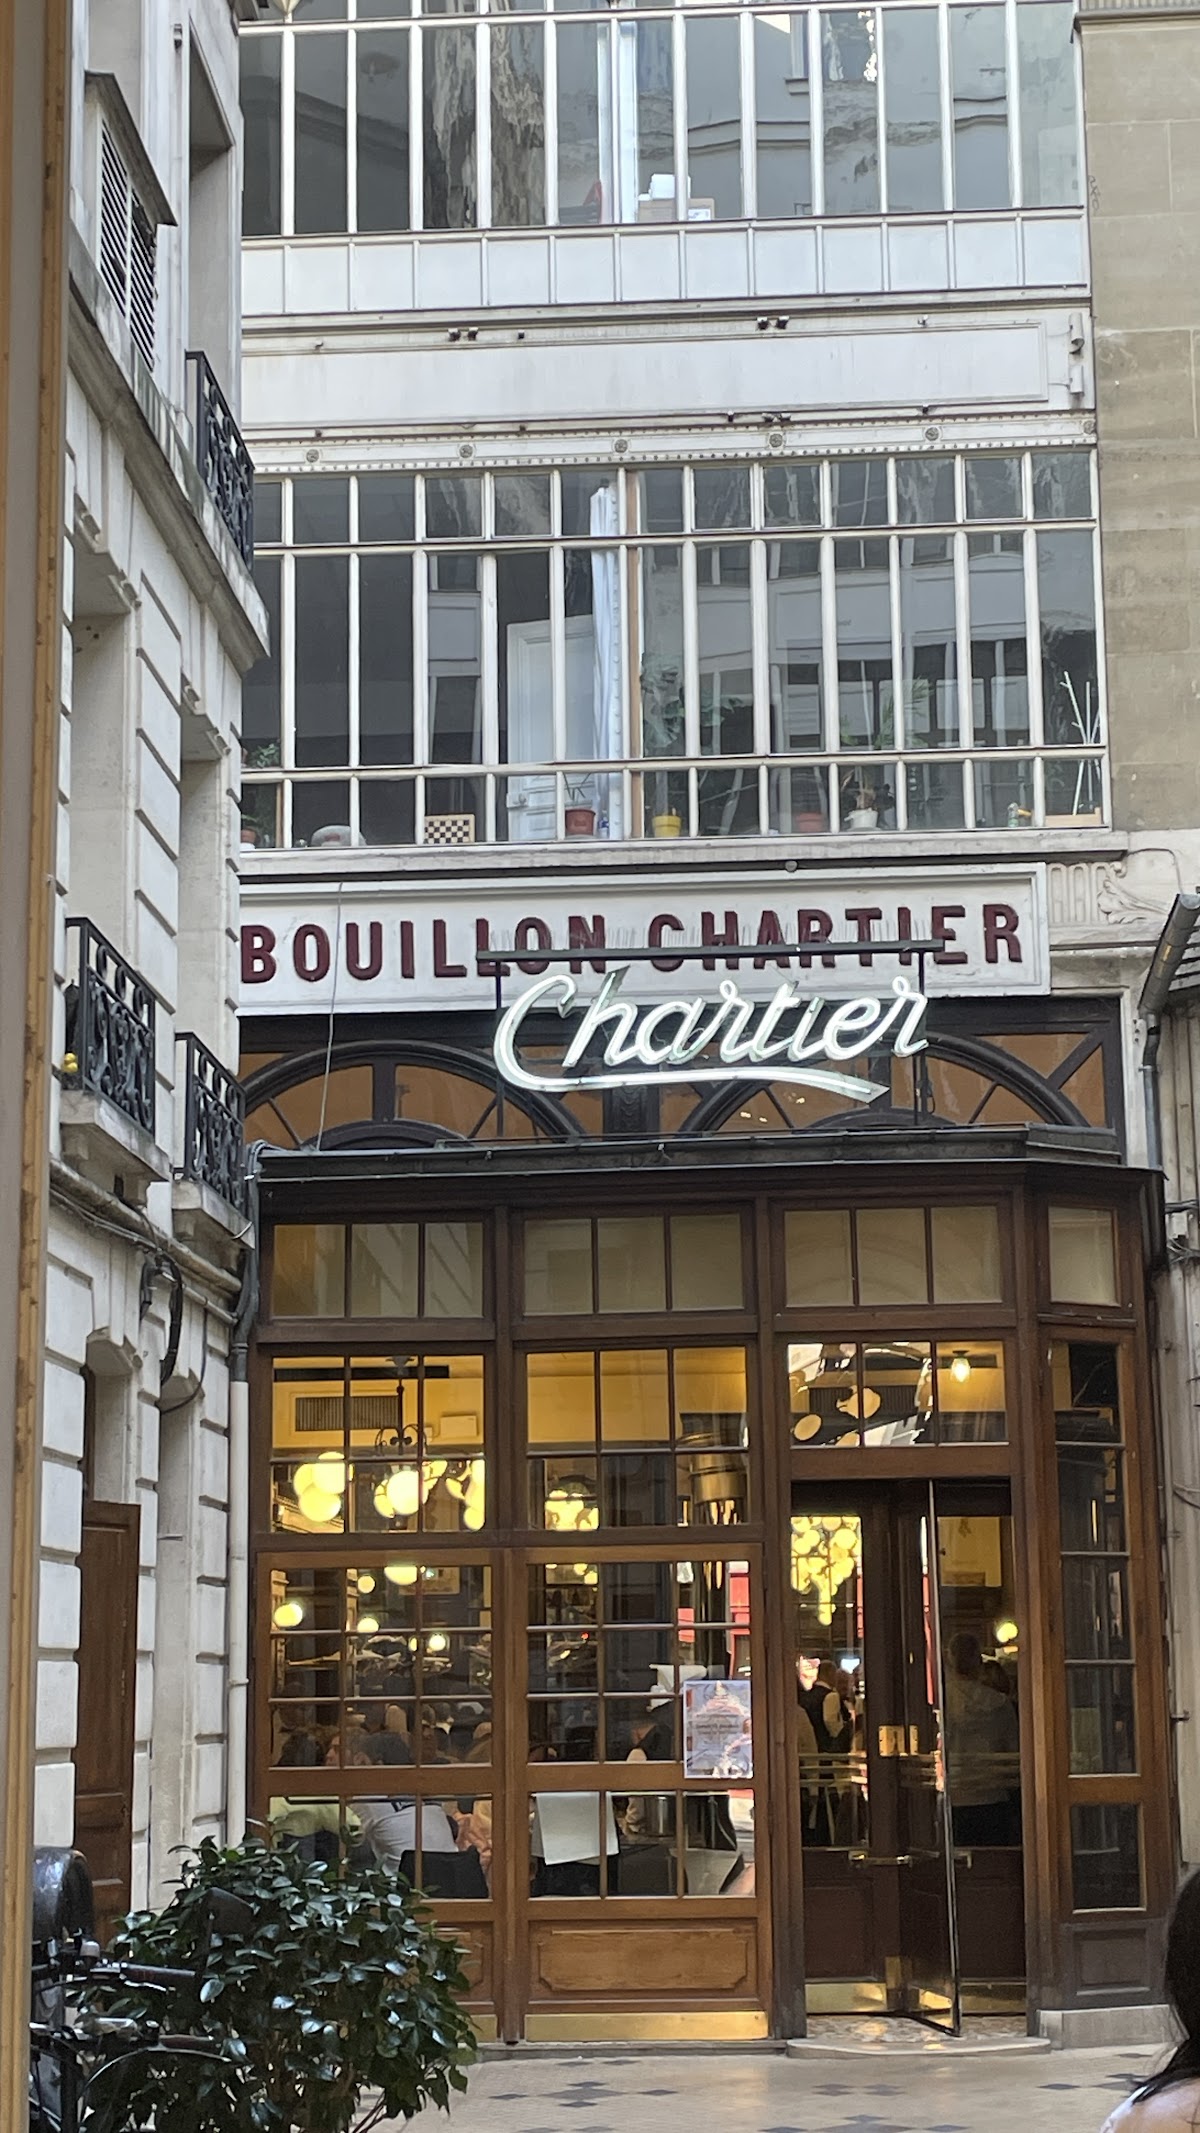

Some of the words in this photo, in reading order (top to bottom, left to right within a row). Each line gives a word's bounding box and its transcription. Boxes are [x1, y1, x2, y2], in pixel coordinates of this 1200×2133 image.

[240, 914, 606, 984] BOUILLON
[648, 903, 1023, 972] CHARTIER
[493, 964, 929, 1103] Chartier
